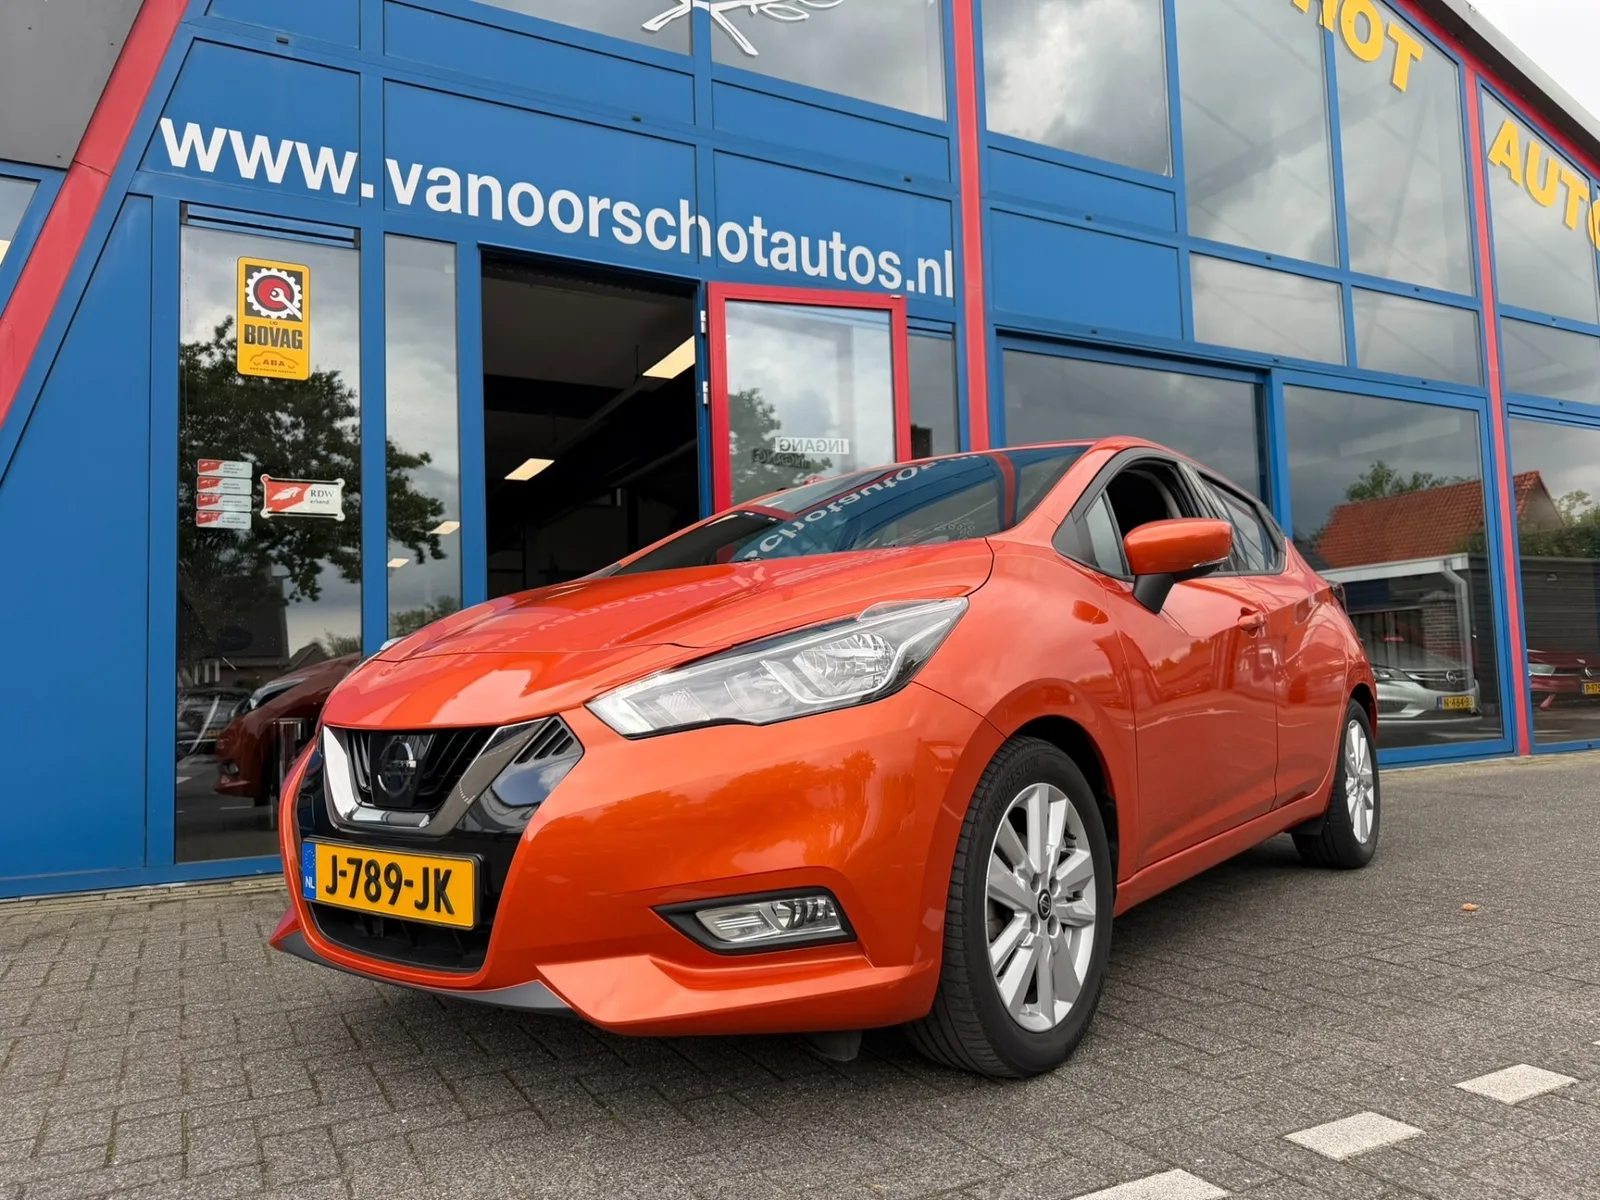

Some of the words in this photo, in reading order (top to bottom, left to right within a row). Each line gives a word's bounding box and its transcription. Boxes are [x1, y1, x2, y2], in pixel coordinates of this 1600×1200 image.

[160, 117, 953, 298] www.vanoorschotautos.nl
[244, 324, 303, 350] BOVAG
[263, 359, 285, 368] ABA
[310, 490, 334, 498] RDW
[305, 875, 315, 889] NL
[325, 854, 455, 915] J-789-JK
